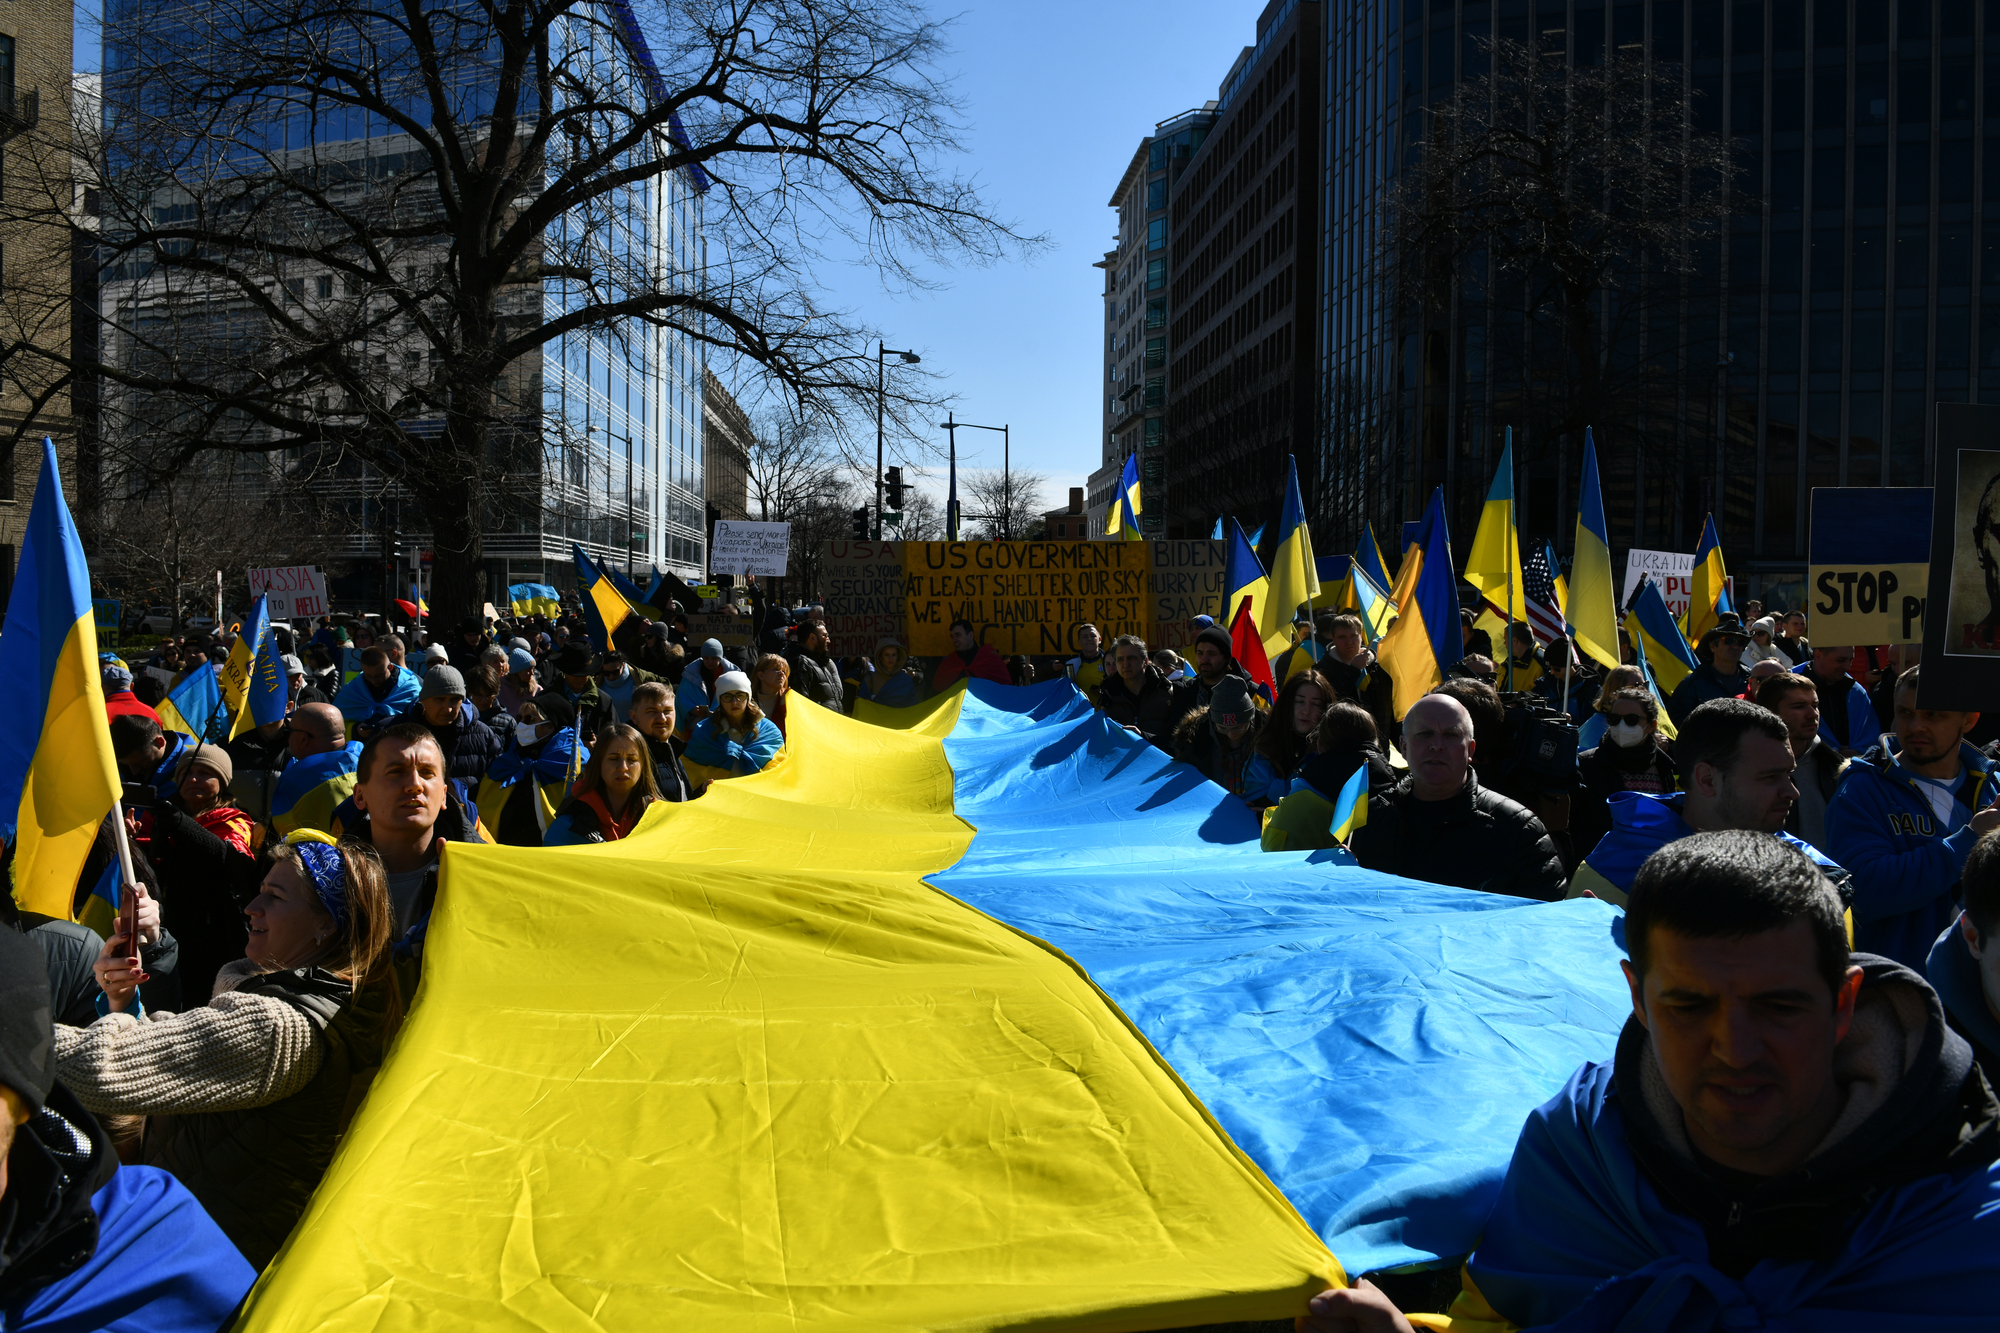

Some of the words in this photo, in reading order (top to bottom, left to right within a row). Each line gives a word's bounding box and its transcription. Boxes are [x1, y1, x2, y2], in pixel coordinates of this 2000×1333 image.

[718, 523, 744, 539] Please
[747, 528, 764, 540] send
[715, 538, 751, 547] Weapons
[831, 541, 895, 559] USA
[926, 543, 967, 569] US
[975, 542, 1127, 569] GOVERMENT
[251, 566, 316, 592] RUSSIA
[825, 565, 857, 578] WHERE
[863, 565, 874, 578] IS
[877, 564, 903, 577] YOUR
[906, 572, 924, 596] AT
[929, 574, 989, 597] LEAST
[993, 573, 1074, 597] SHELTER
[1079, 571, 1110, 595] OUR
[1114, 569, 1144, 594] SKY
[1147, 572, 1198, 594] HURRY
[1204, 571, 1225, 593] UP
[1816, 571, 1899, 615] STOP
[271, 600, 285, 610] TO
[295, 596, 326, 617] HELL
[824, 597, 906, 616] ASSURANCE
[911, 601, 941, 623] WE
[994, 599, 1053, 623] HANDLE
[1057, 598, 1086, 622] THE
[1094, 597, 1140, 621] REST
[1158, 596, 1219, 620] SAVE
[706, 615, 733, 624] NATO
[708, 624, 721, 634] THE
[825, 615, 907, 635] BUDAPEST
[1223, 713, 1238, 726] R
